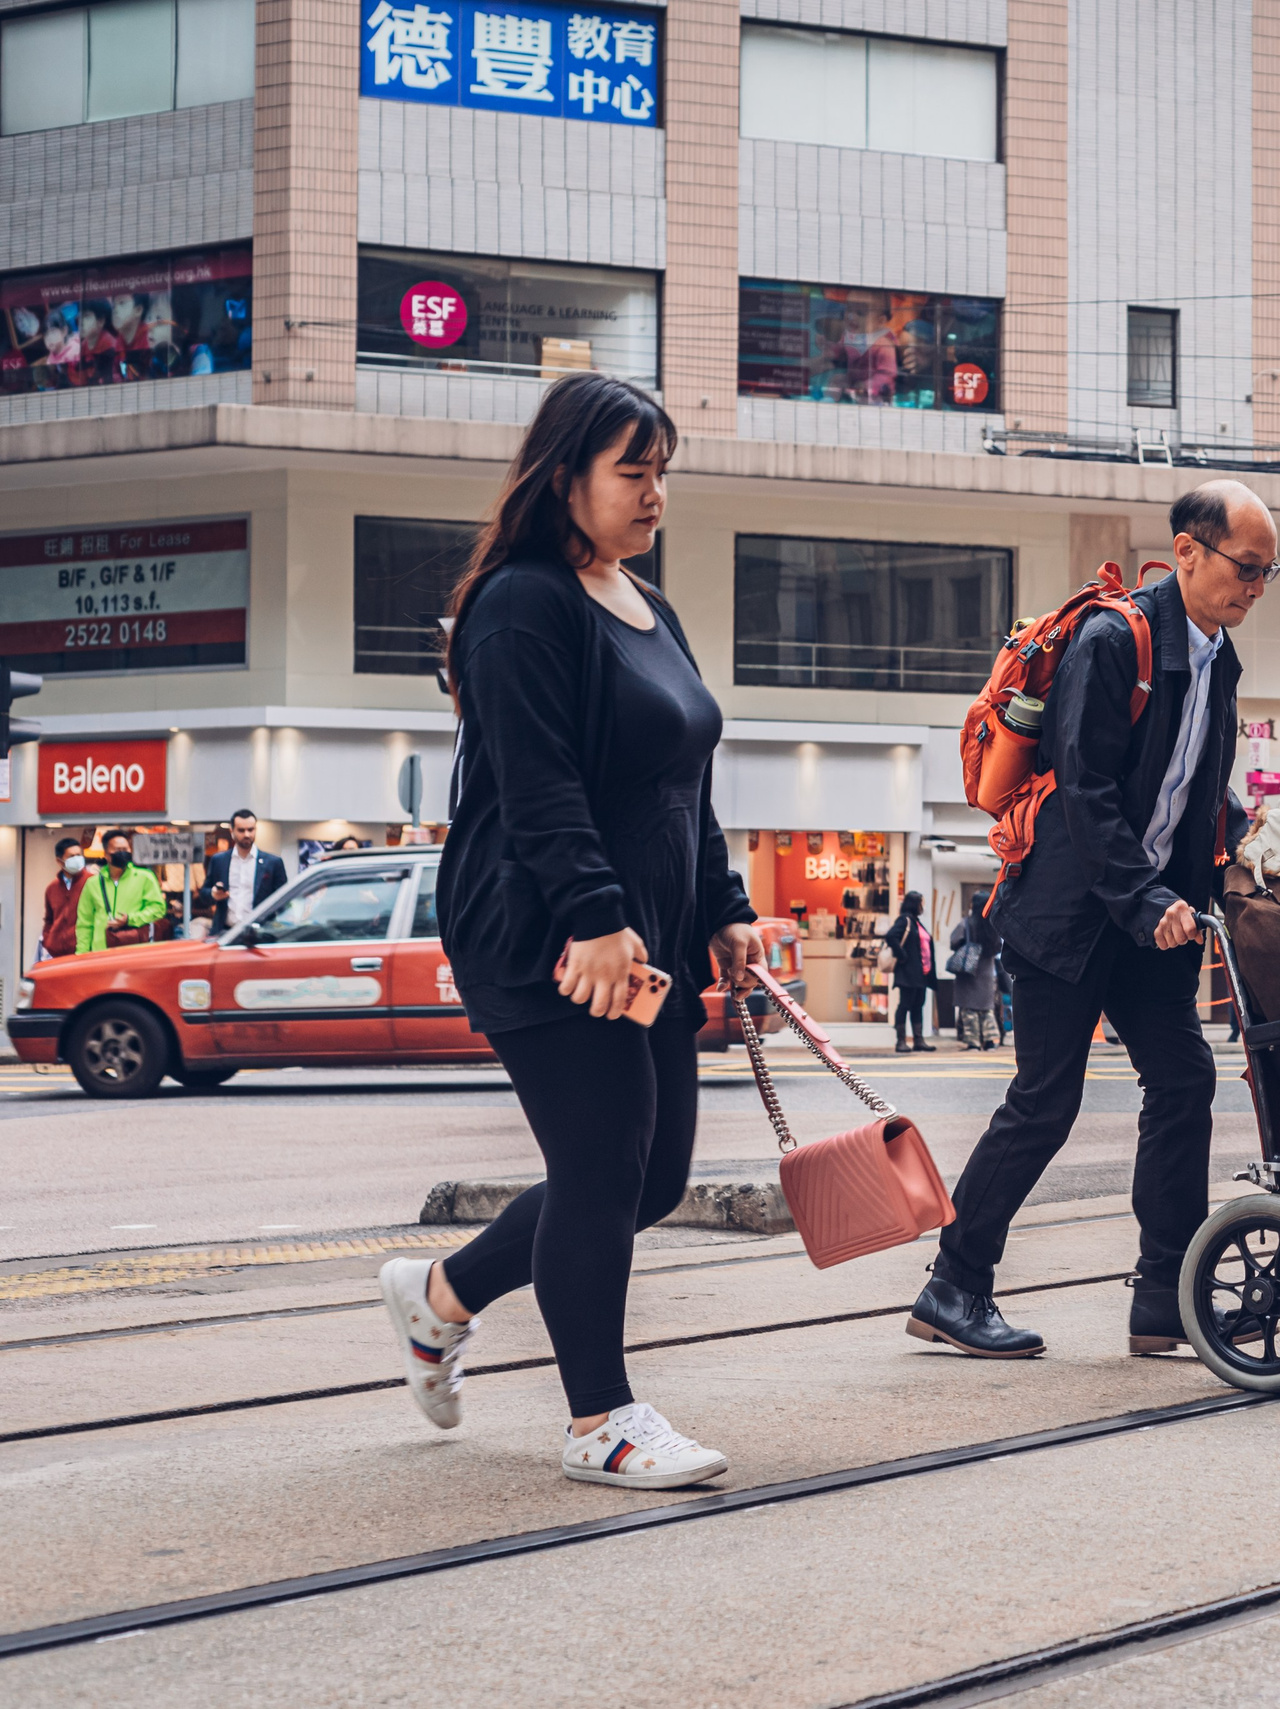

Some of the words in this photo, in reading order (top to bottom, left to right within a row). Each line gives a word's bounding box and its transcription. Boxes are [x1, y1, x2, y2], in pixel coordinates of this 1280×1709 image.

[367, 0, 555, 103] 德豐
[567, 13, 656, 67] 教育
[567, 68, 655, 120] 中心
[411, 294, 457, 320] ESF
[558, 306, 618, 322] LEARNING
[953, 371, 983, 389] ESF
[119, 533, 143, 551] For
[149, 531, 191, 549] Lease
[100, 564, 129, 586] G/F
[133, 564, 145, 584] &
[150, 560, 176, 582] 1/F
[75, 593, 130, 616] 10,113
[65, 622, 111, 647] 2522
[119, 619, 167, 644] 0148
[53, 757, 145, 794] Baleno
[434, 983, 462, 1003] TA
